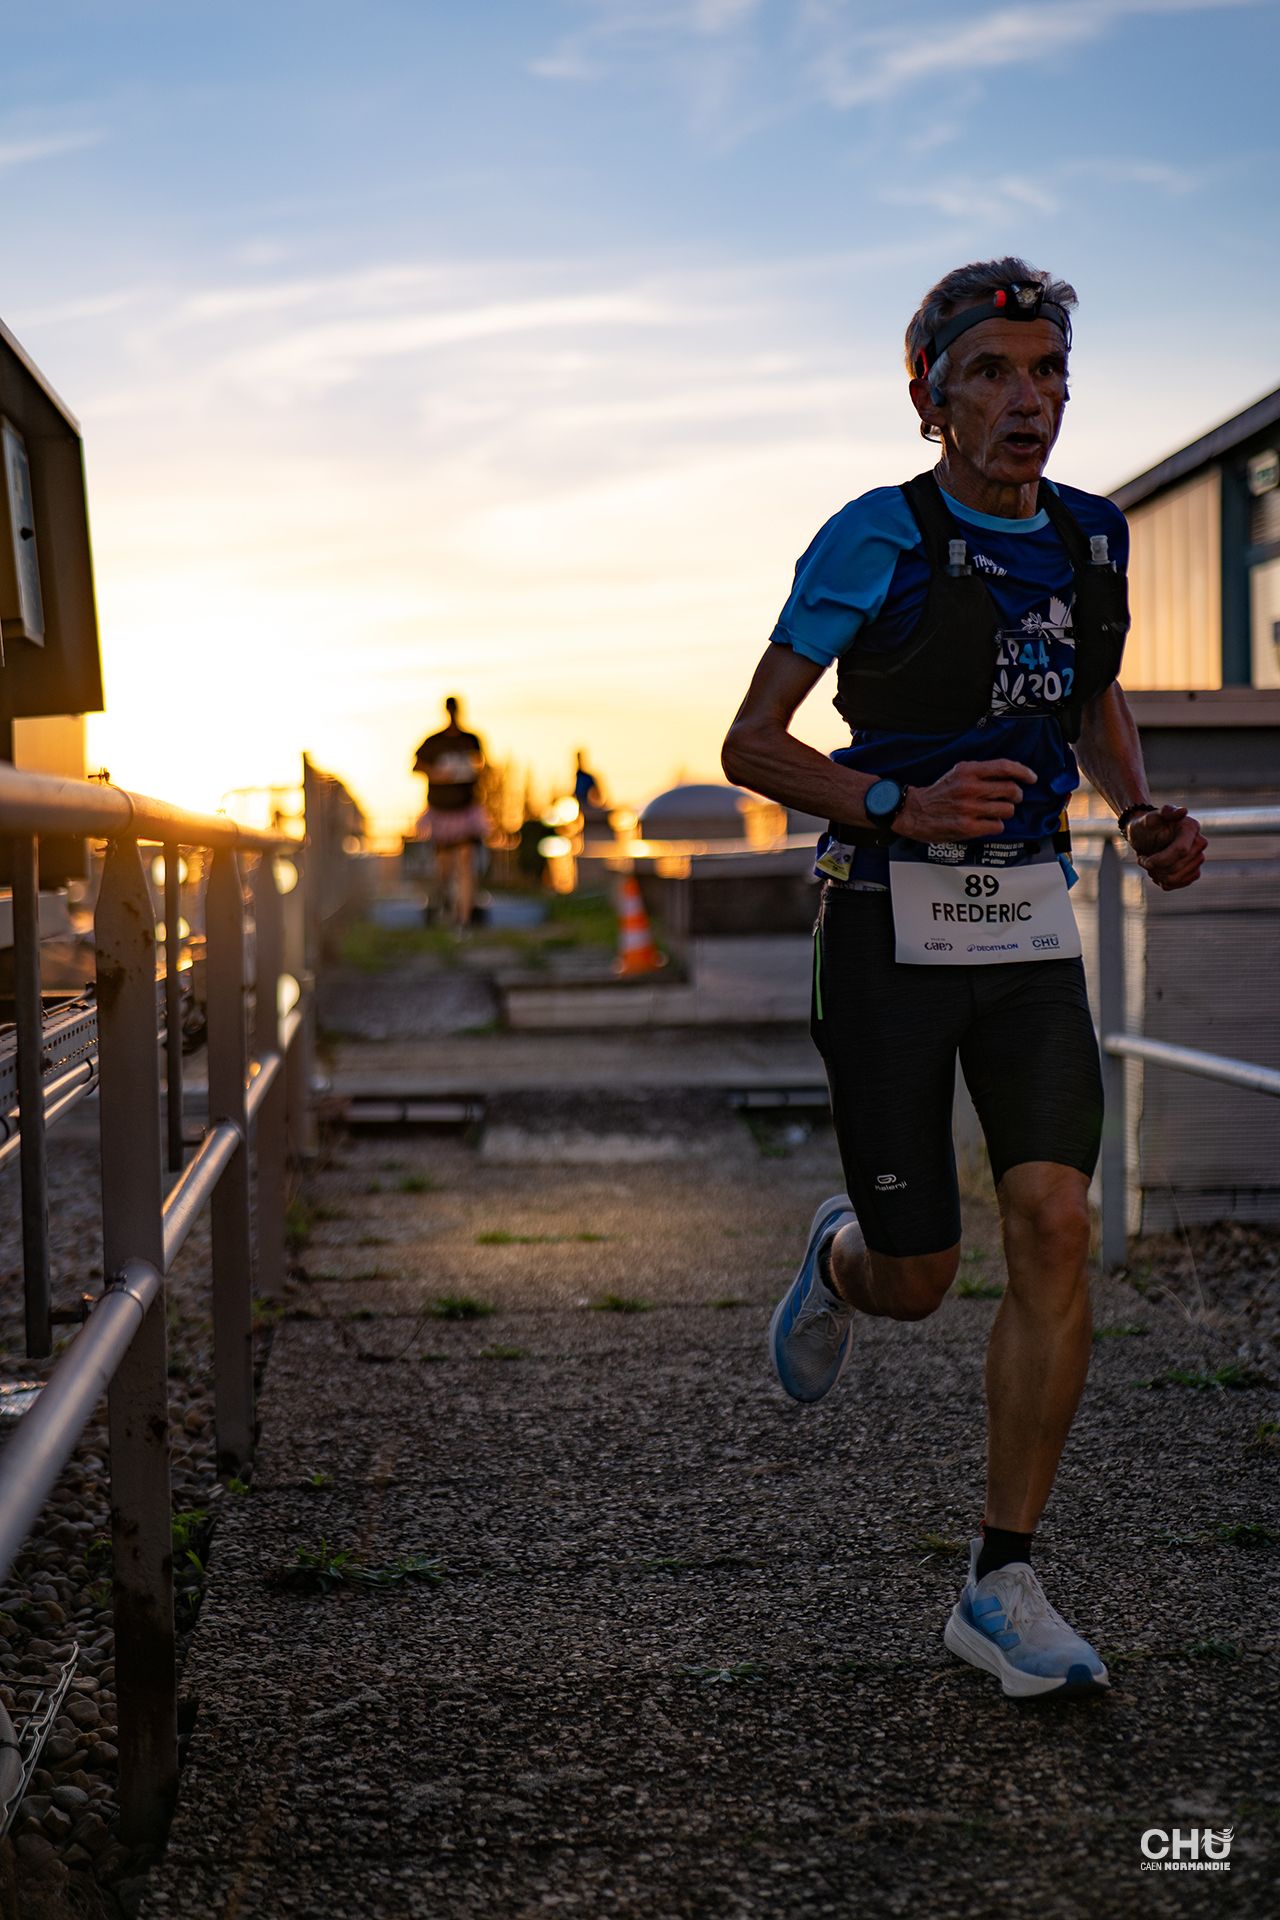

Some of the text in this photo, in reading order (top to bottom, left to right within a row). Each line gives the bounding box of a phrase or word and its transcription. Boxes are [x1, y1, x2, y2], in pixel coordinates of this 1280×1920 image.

[1028, 667, 1075, 701] 202
[928, 846, 965, 858] bouge
[964, 874, 1000, 898] 89
[931, 901, 1033, 923] FREDERIC
[976, 943, 1019, 952] DECATHLON
[1032, 937, 1059, 948] CHU
